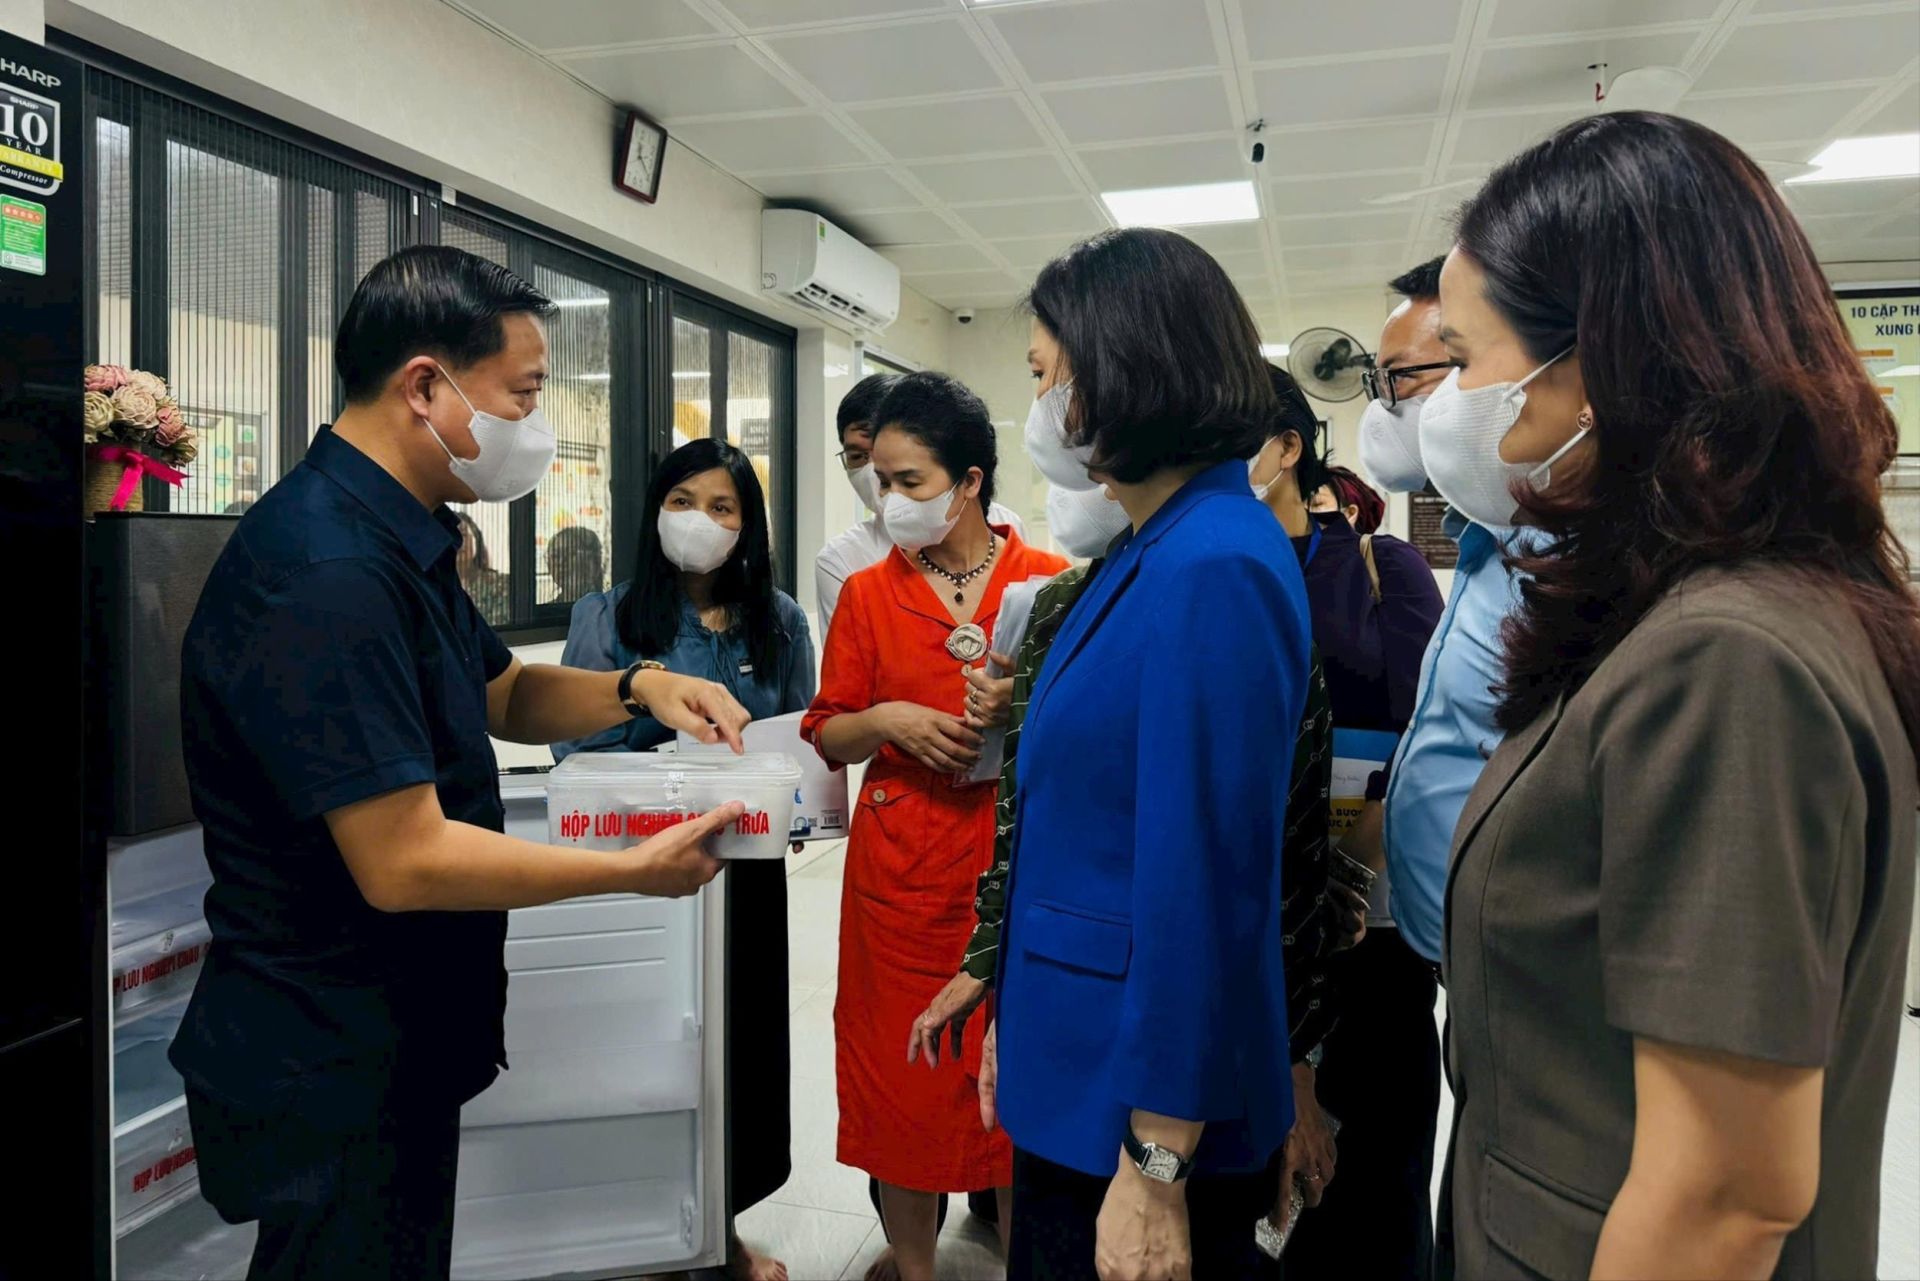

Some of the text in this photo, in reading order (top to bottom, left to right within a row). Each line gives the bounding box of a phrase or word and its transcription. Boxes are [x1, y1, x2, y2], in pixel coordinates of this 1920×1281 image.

[0, 103, 48, 146] 10
[6, 138, 41, 155] YEAR
[0, 164, 48, 185] Compressor
[1851, 306, 1866, 318] 10
[1901, 304, 1920, 317] TH
[1875, 323, 1913, 336] XUNG
[561, 809, 590, 842] HỘP
[595, 811, 622, 837] LƯU
